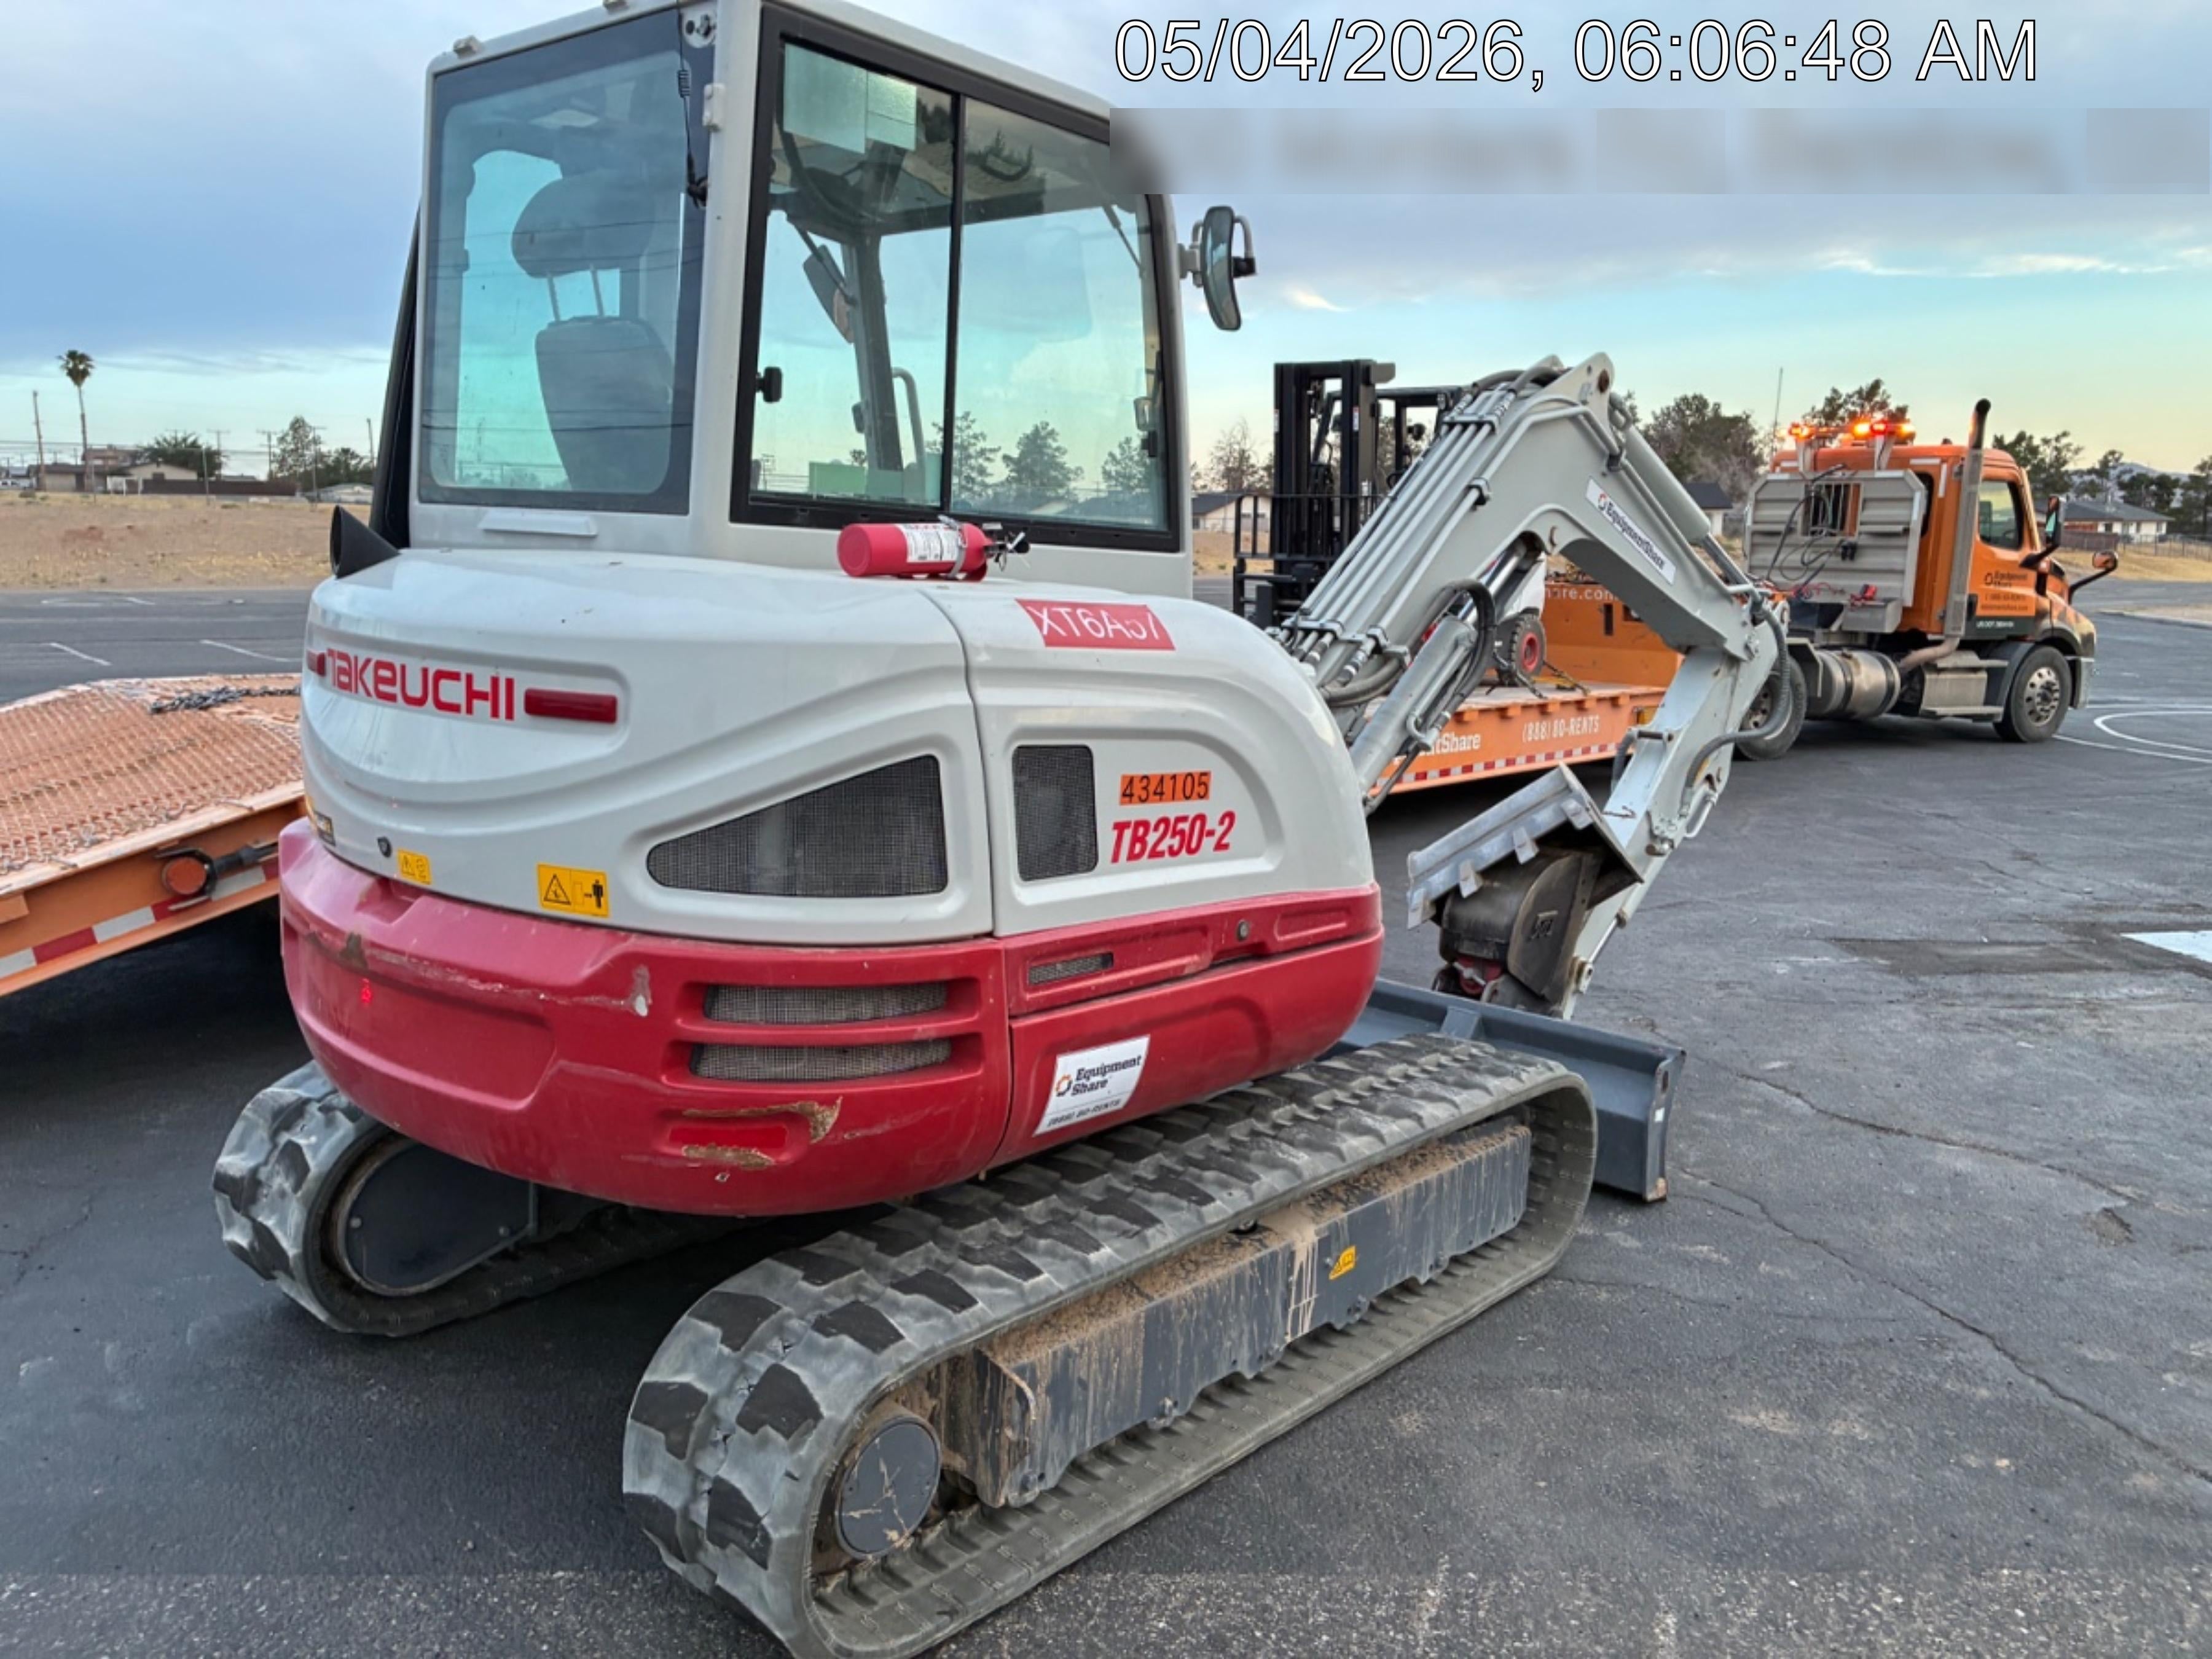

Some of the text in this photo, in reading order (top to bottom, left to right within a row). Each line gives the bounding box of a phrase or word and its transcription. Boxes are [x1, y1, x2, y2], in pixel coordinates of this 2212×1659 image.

[1122, 772, 1209, 803] 434105
[1110, 810, 1236, 863] TB250-2
[1075, 1055, 1142, 1080] Equipment
[1071, 1079, 1108, 1097] Share
